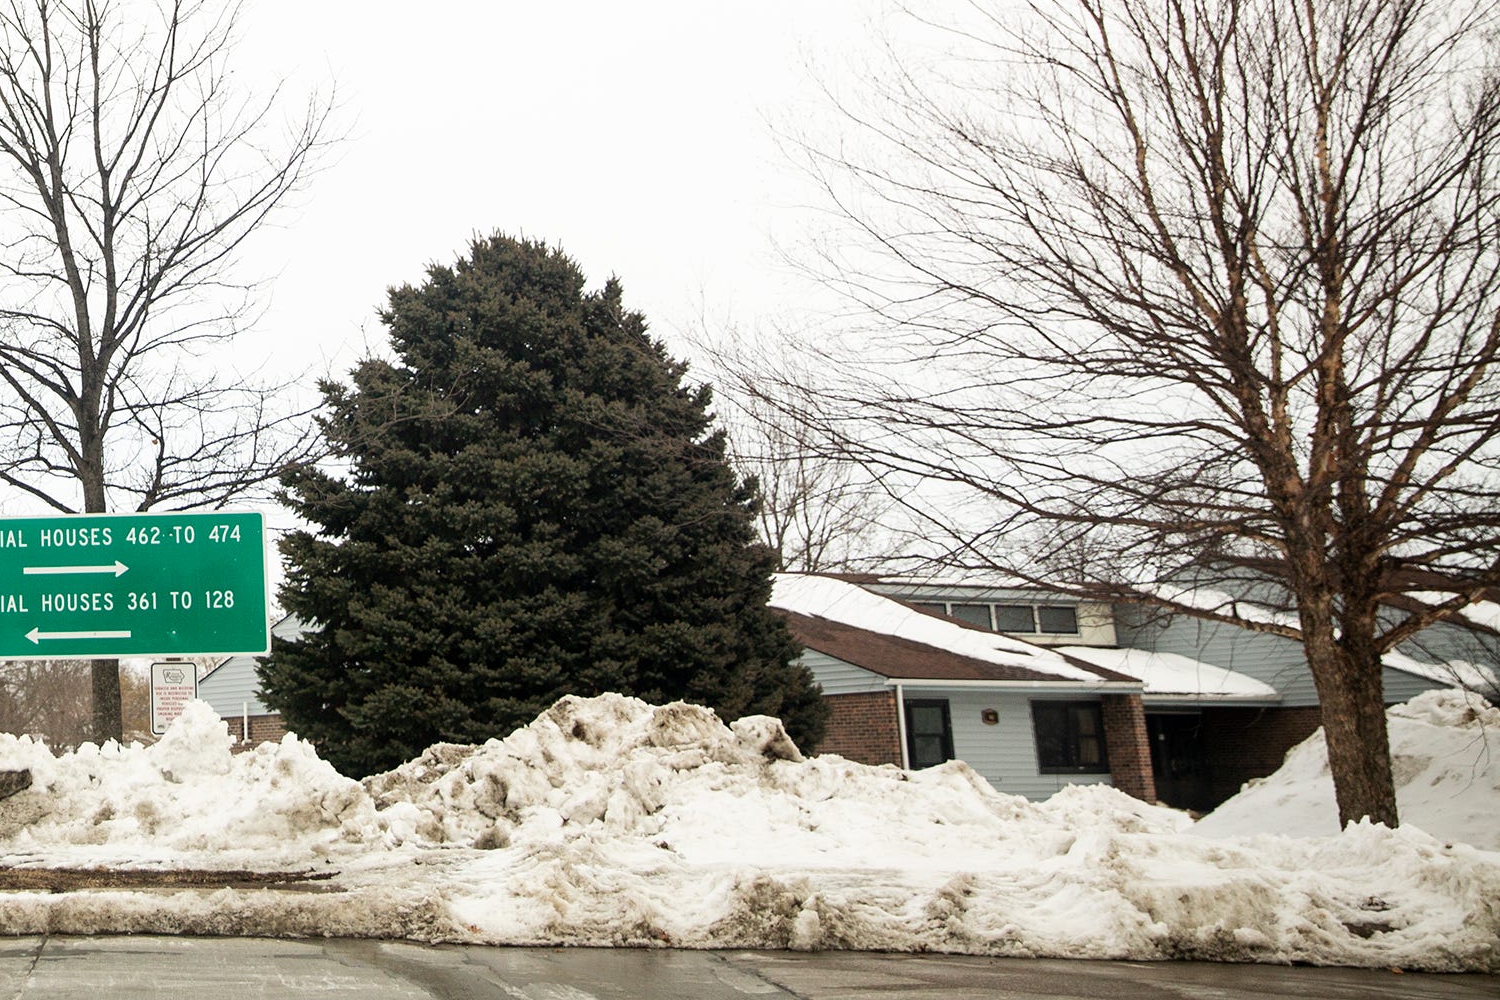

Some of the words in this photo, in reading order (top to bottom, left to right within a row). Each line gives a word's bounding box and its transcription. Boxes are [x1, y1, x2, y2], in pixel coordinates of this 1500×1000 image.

[40, 527, 113, 547] HOUSES
[125, 526, 161, 545] 462
[173, 525, 195, 544] TO
[208, 524, 241, 543] 474
[41, 592, 114, 612] HOUSES
[127, 591, 157, 611] 361
[169, 591, 192, 610] TO
[205, 590, 235, 609] 128
